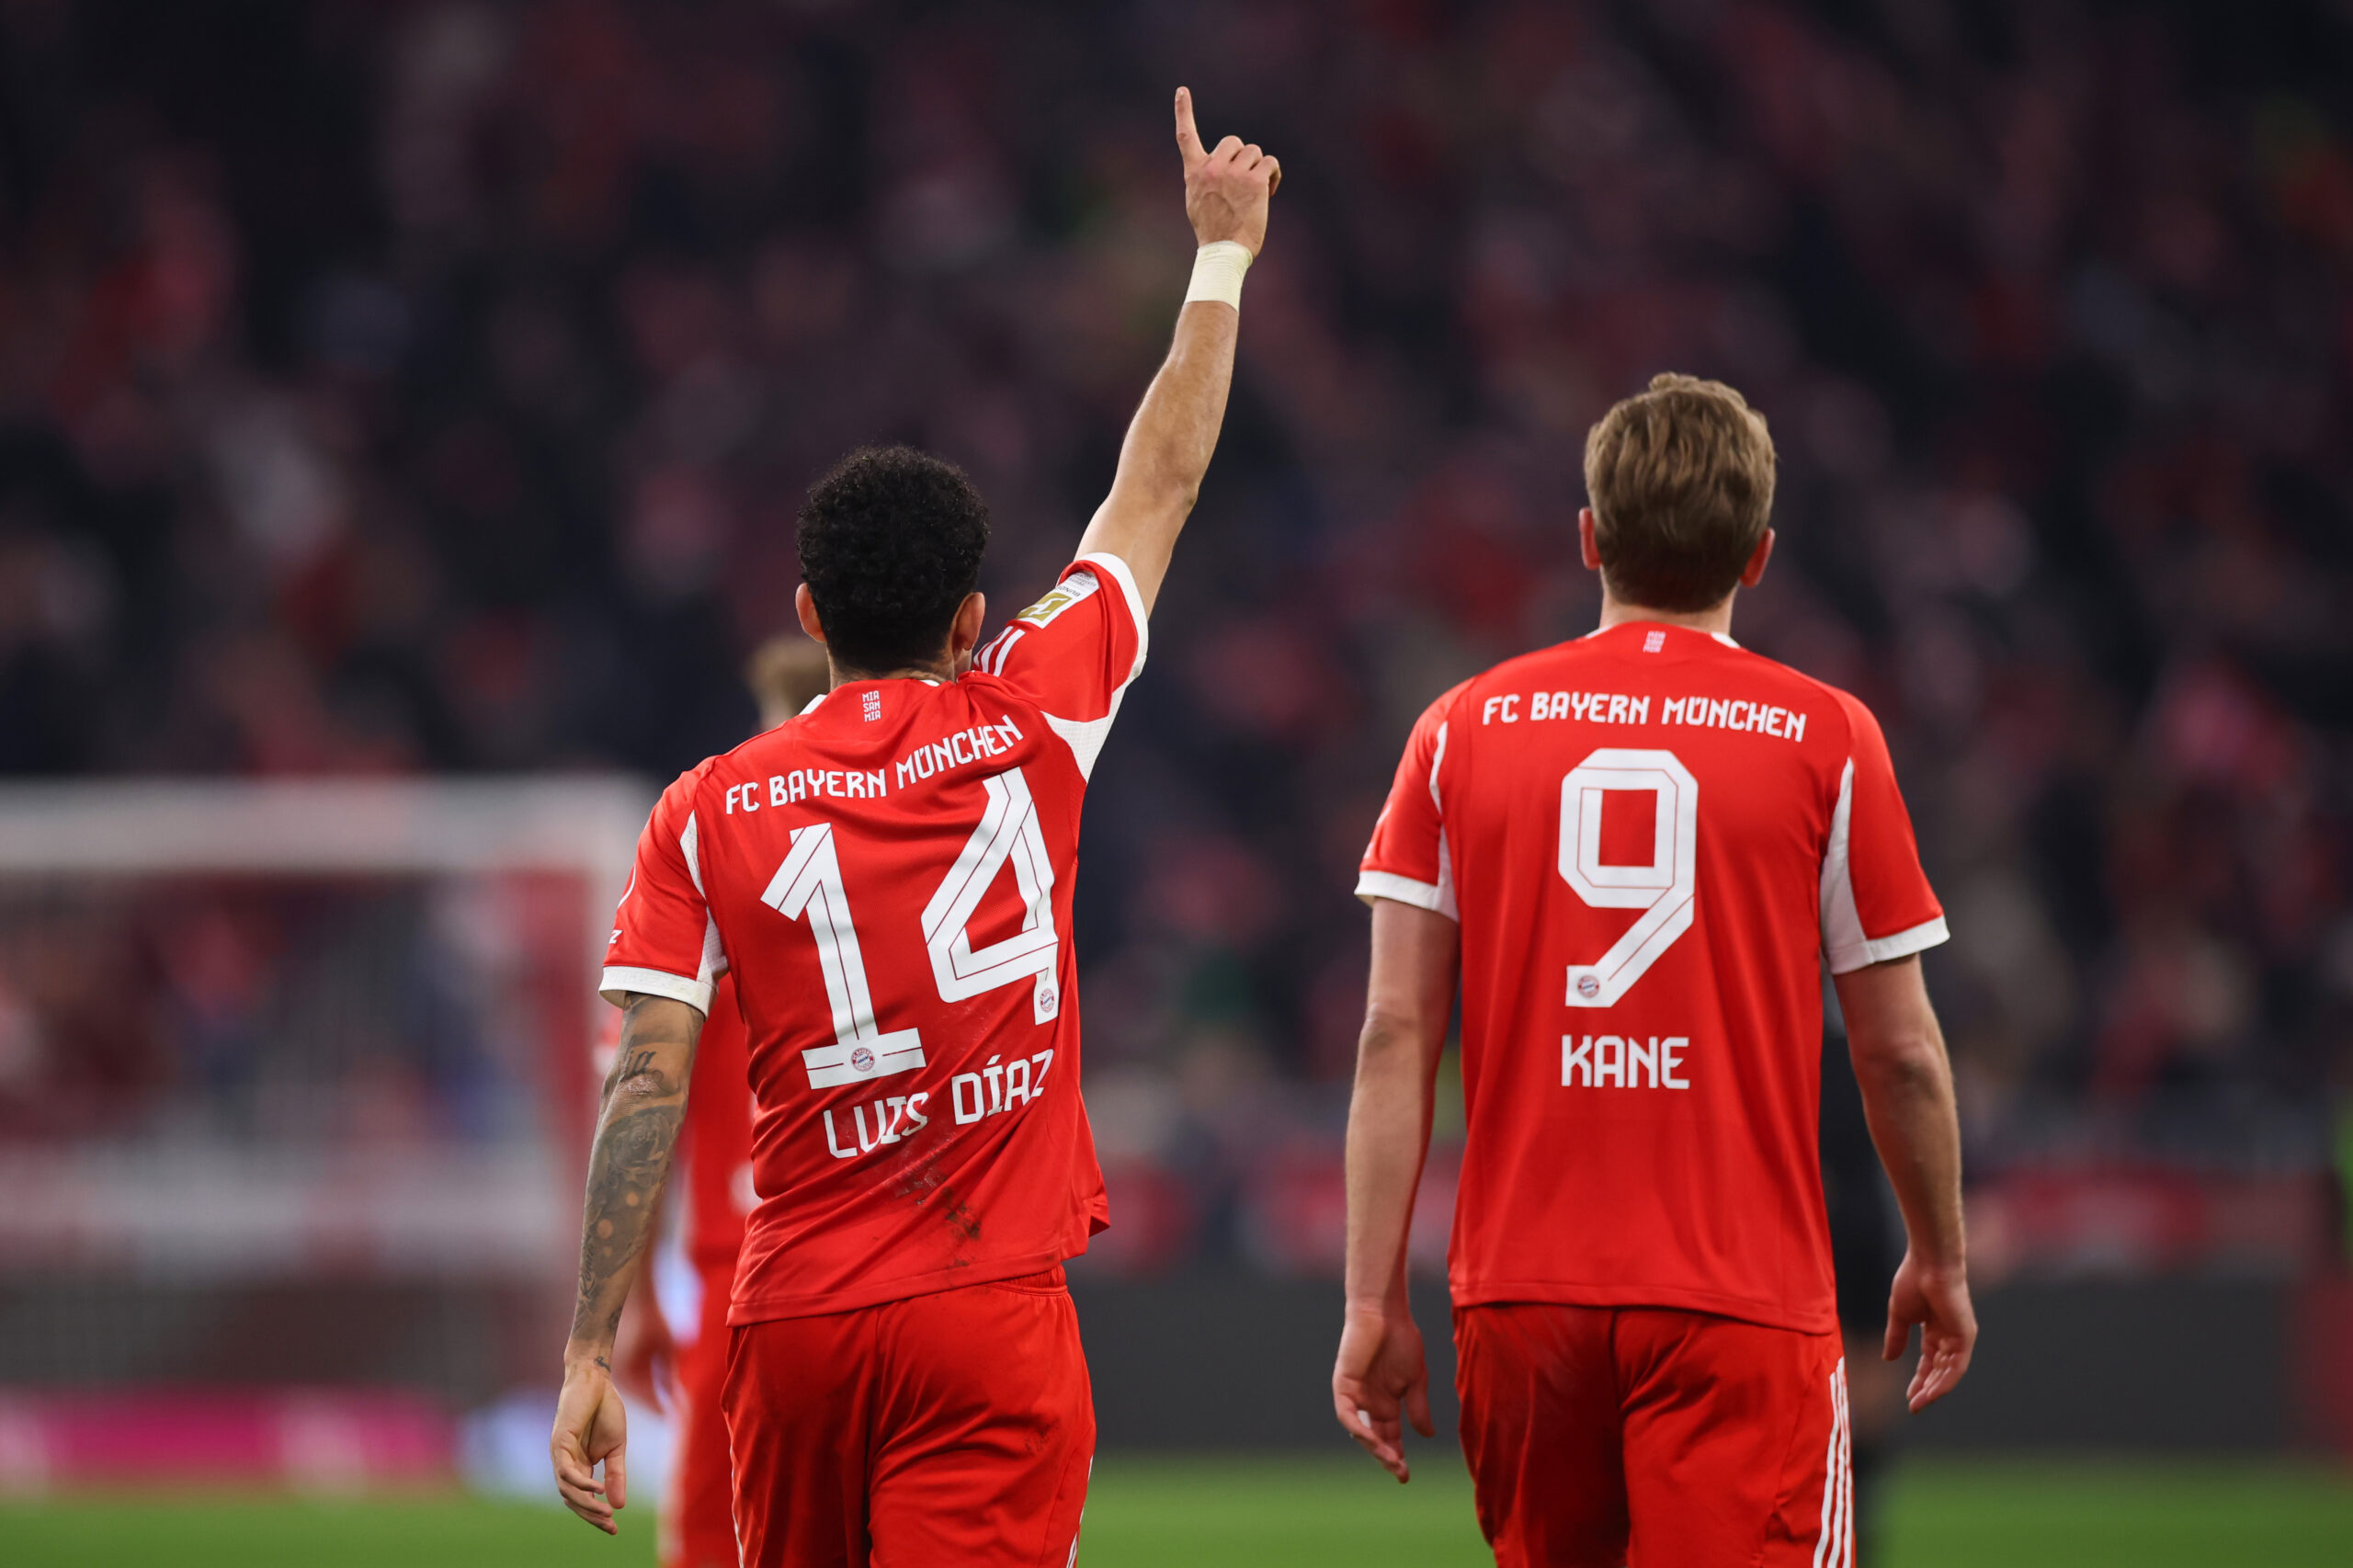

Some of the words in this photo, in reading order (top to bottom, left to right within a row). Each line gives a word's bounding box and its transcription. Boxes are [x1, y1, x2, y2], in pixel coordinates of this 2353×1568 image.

[861, 690, 880, 702] MIA
[862, 700, 881, 712] SAN
[864, 710, 881, 722] MIA
[1483, 694, 1520, 725] FC
[1530, 691, 1651, 725] BAYERN
[1661, 696, 1807, 743] MÜNCHEN
[725, 782, 760, 814] FC
[768, 768, 887, 807] BAYERN
[895, 714, 1024, 790] MÜNCHEN
[1558, 747, 1699, 1007] 9
[760, 766, 1060, 1089] 14
[1562, 1034, 1689, 1089] KANE
[824, 1092, 929, 1159] LUIS
[951, 1049, 1054, 1126] DÍAZ
